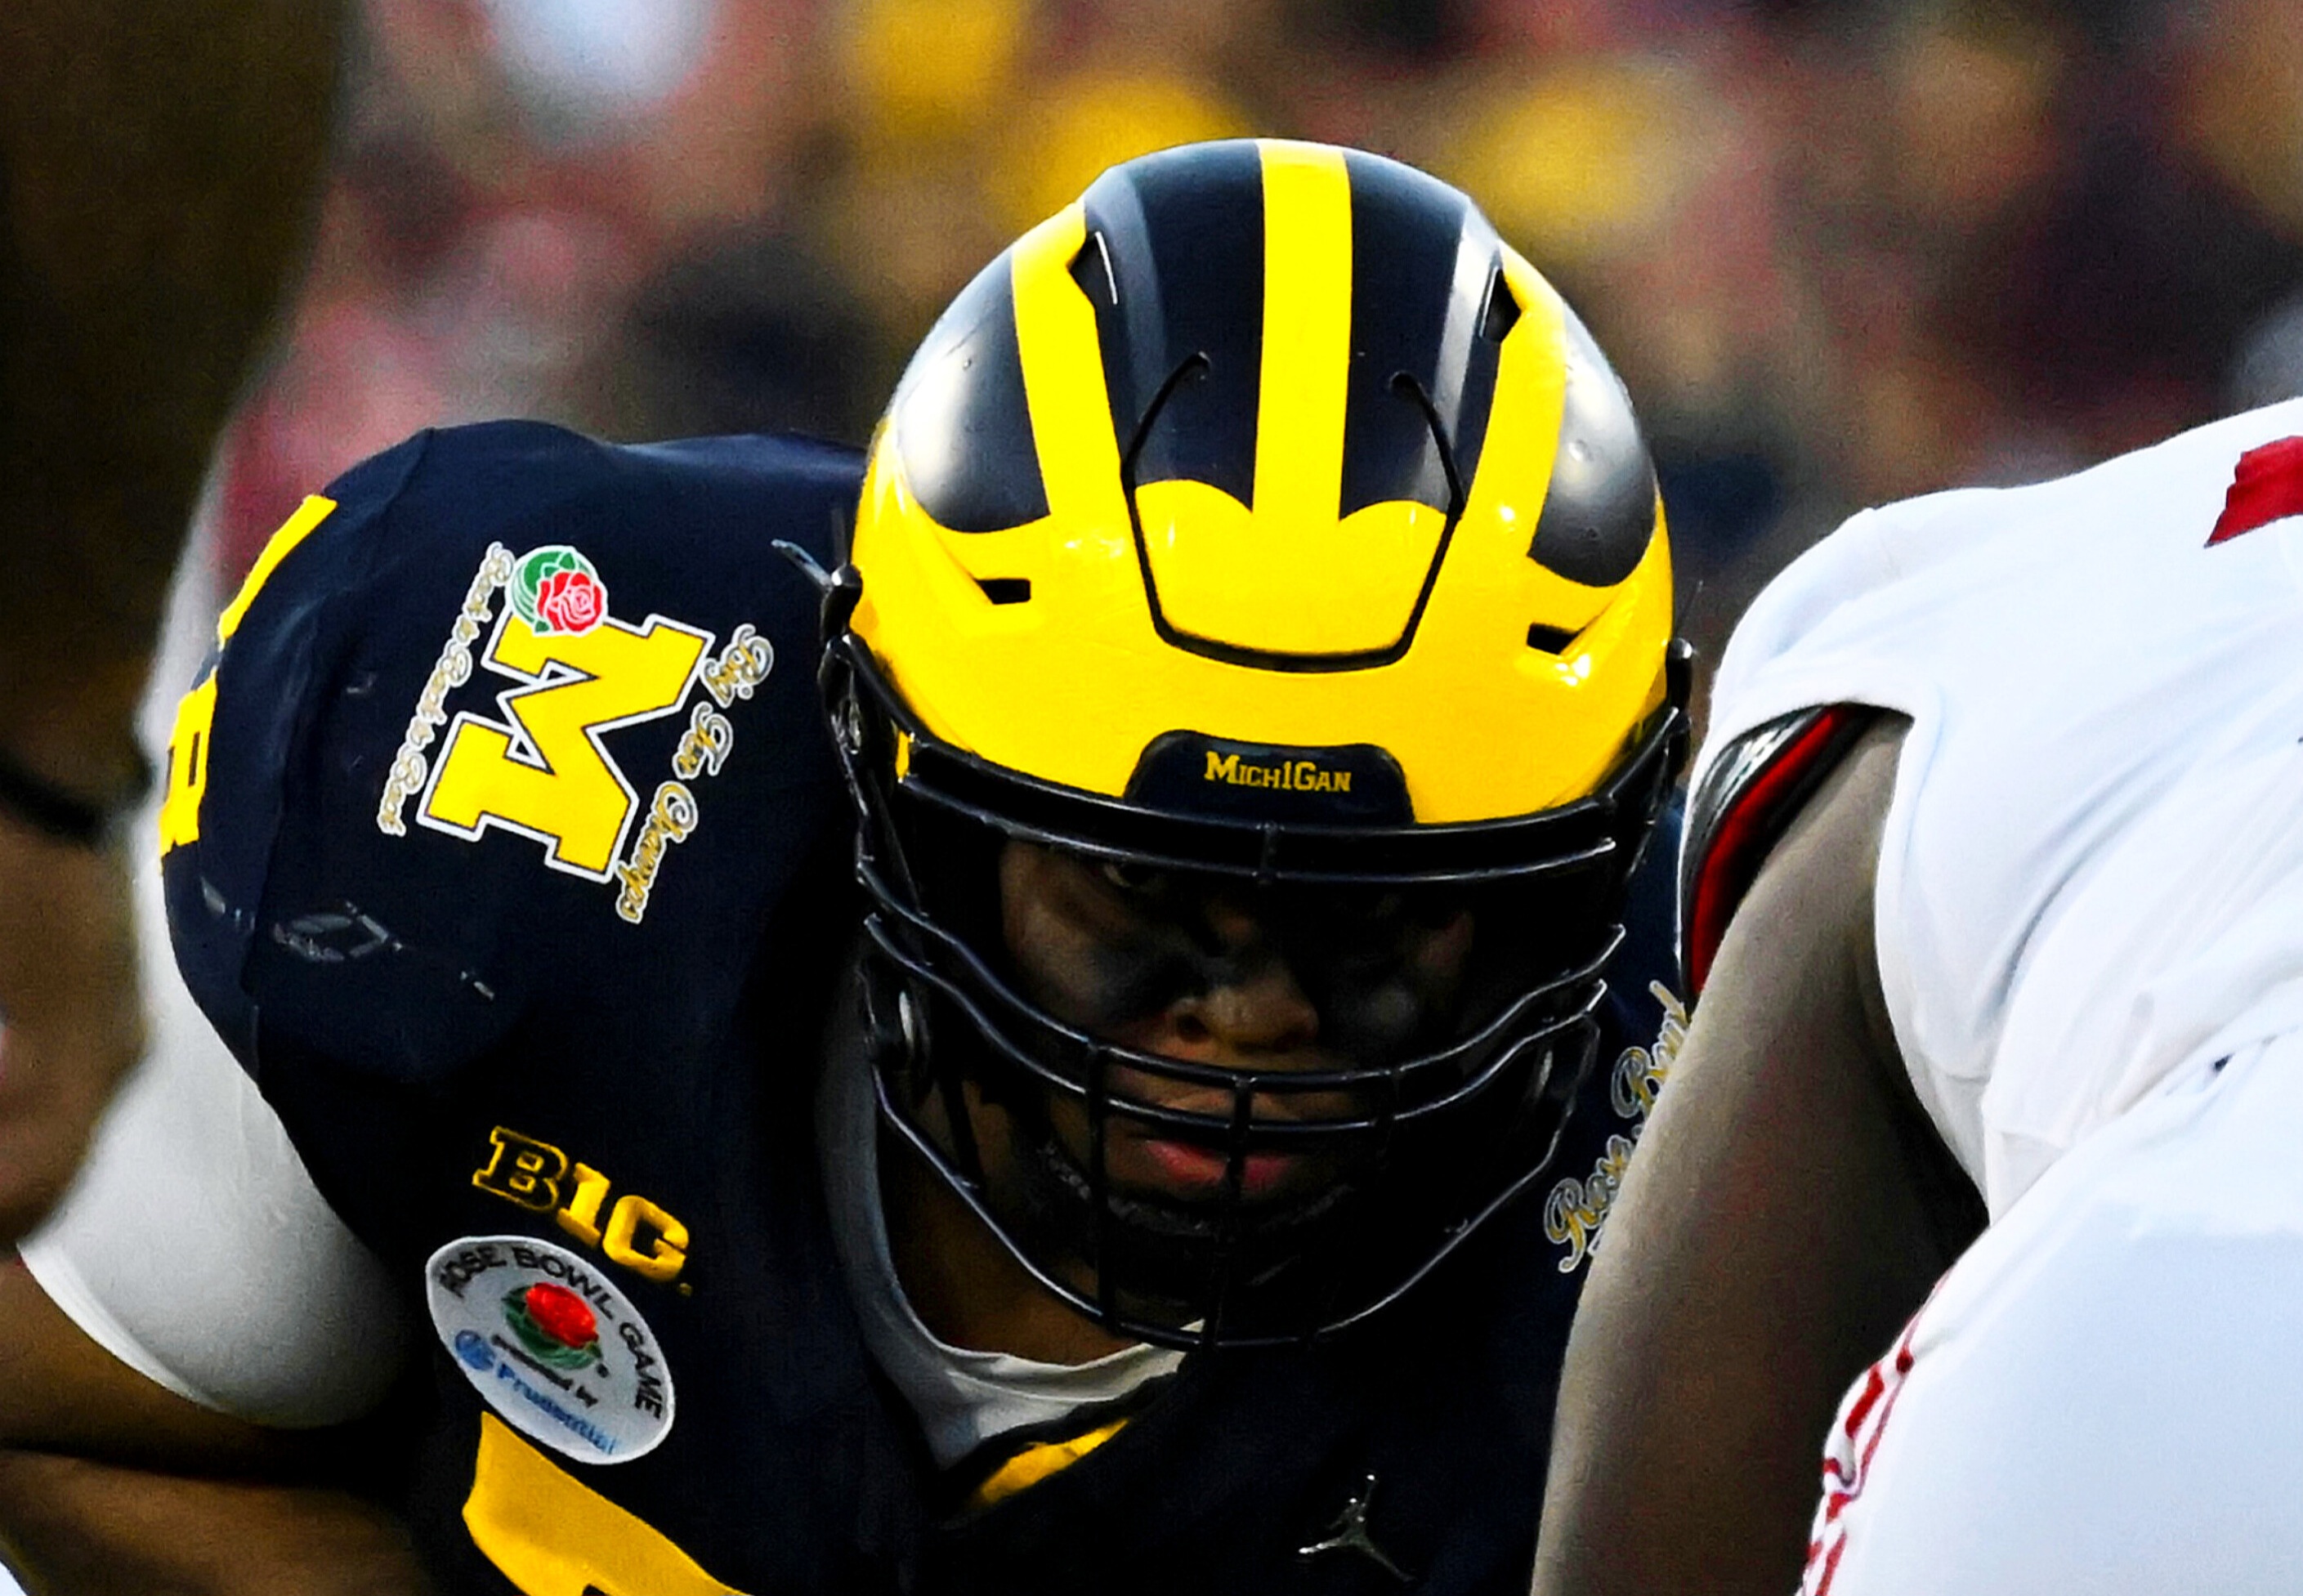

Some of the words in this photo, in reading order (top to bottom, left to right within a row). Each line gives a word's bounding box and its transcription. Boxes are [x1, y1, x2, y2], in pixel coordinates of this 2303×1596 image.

[700, 624, 774, 708] Big
[417, 614, 715, 884] M
[673, 701, 734, 780] Ten
[615, 780, 699, 924] Champs
[511, 1245, 615, 1321] BOWL
[619, 1321, 663, 1419] GAME
